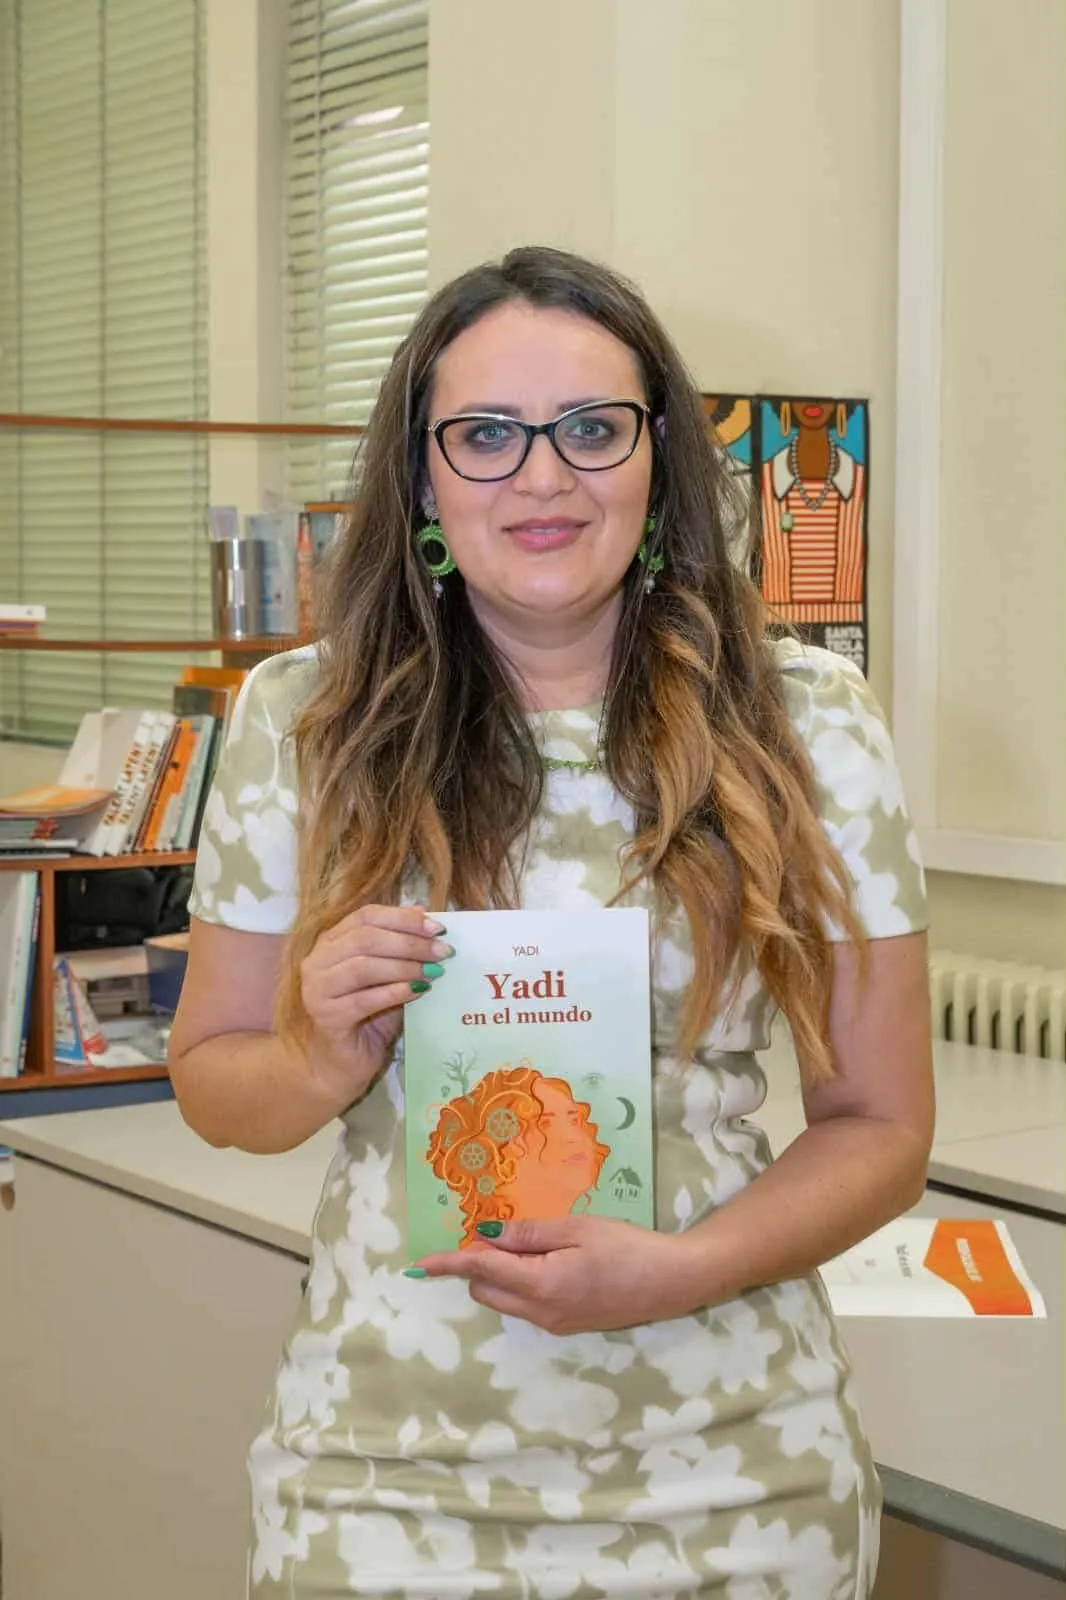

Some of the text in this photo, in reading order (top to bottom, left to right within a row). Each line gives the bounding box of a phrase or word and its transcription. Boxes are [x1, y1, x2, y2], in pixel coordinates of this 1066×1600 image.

[825, 626, 864, 639] SANTA
[121, 741, 144, 783] LATENT
[137, 742, 160, 783] LATENT
[512, 945, 539, 957] YADI
[484, 970, 567, 999] Yadi
[461, 1005, 592, 1025] en el mundo
